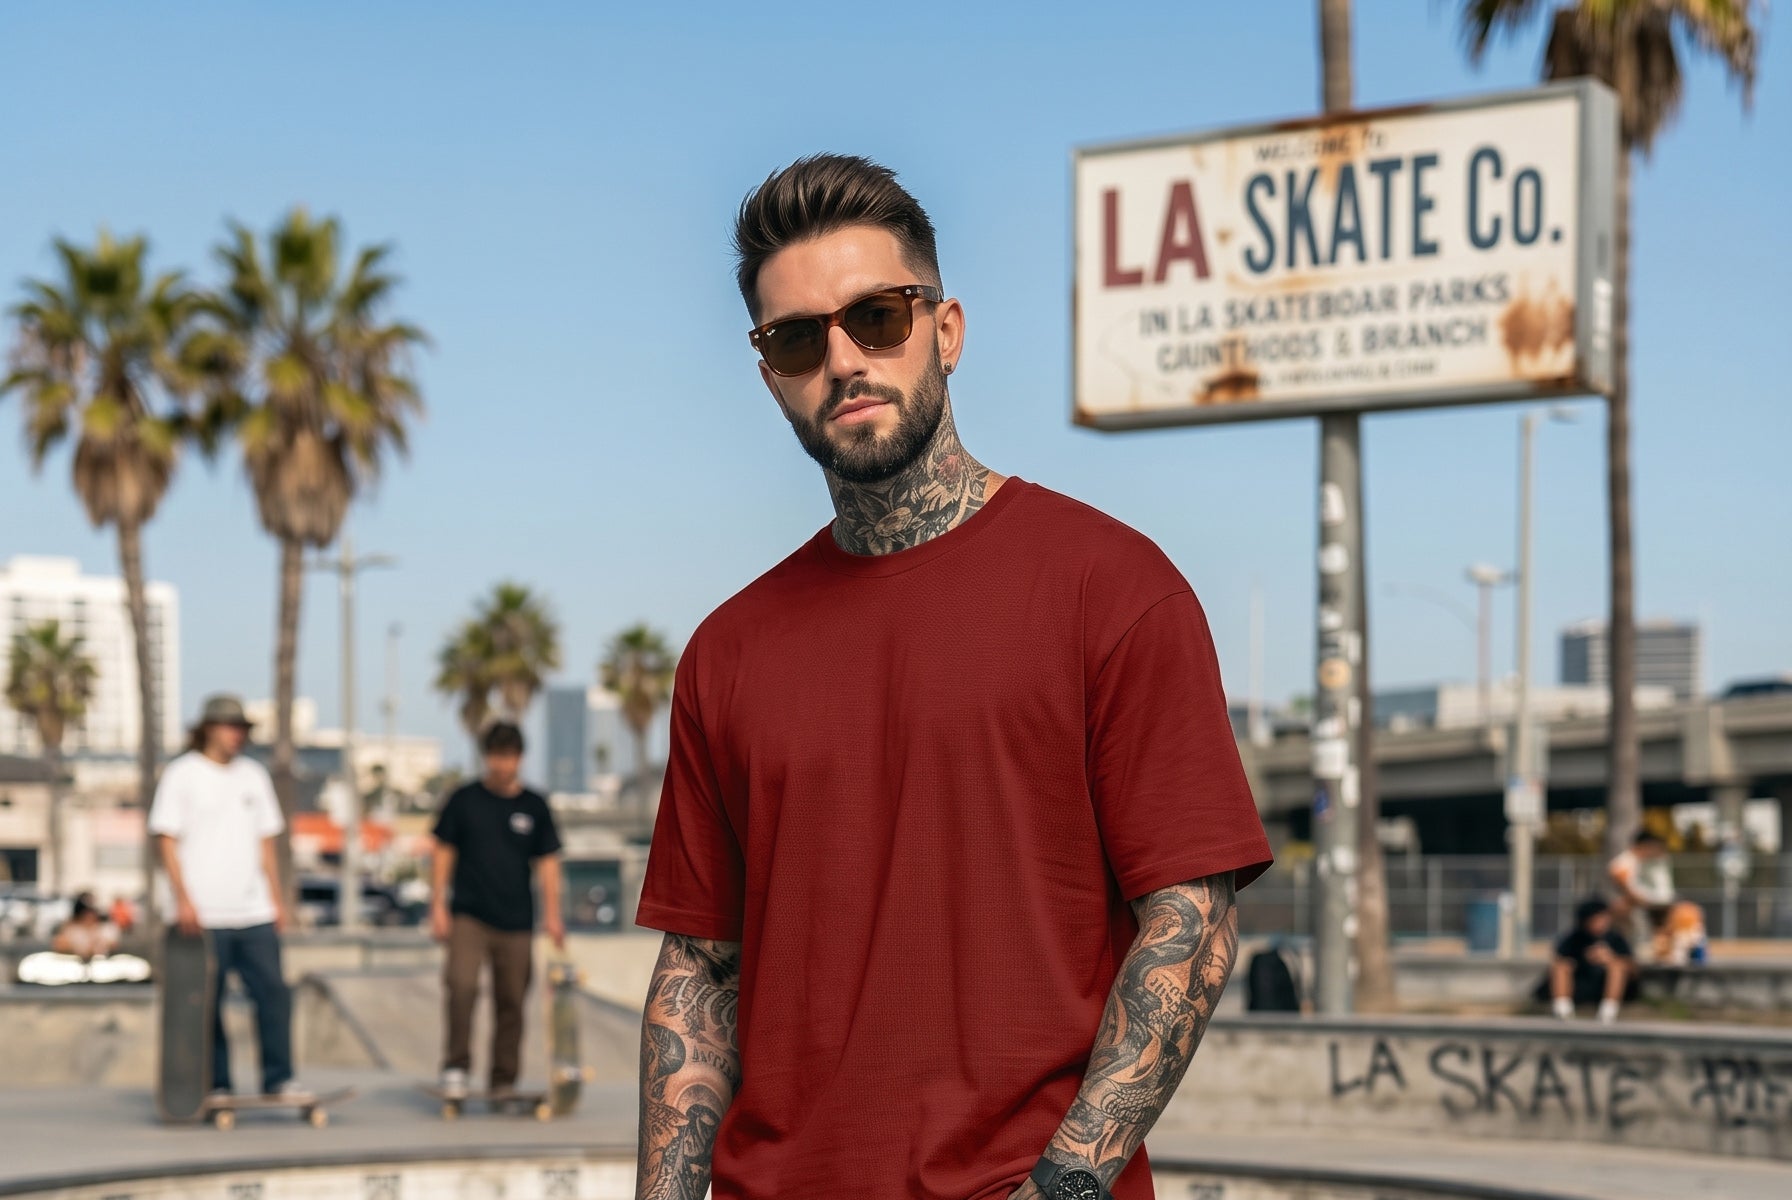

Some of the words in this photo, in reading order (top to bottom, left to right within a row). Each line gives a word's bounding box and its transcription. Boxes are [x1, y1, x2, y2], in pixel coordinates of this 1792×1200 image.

[1103, 179, 1211, 288] LA
[1244, 153, 1438, 275] SKATE
[1467, 146, 1562, 250] Co.
[1140, 307, 1169, 337] IN
[1177, 303, 1213, 334] LA
[1408, 273, 1510, 311] PARKS
[1361, 313, 1489, 356] BRANCH
[1328, 1037, 1409, 1098] LA
[1428, 1042, 1652, 1131] SKATE
